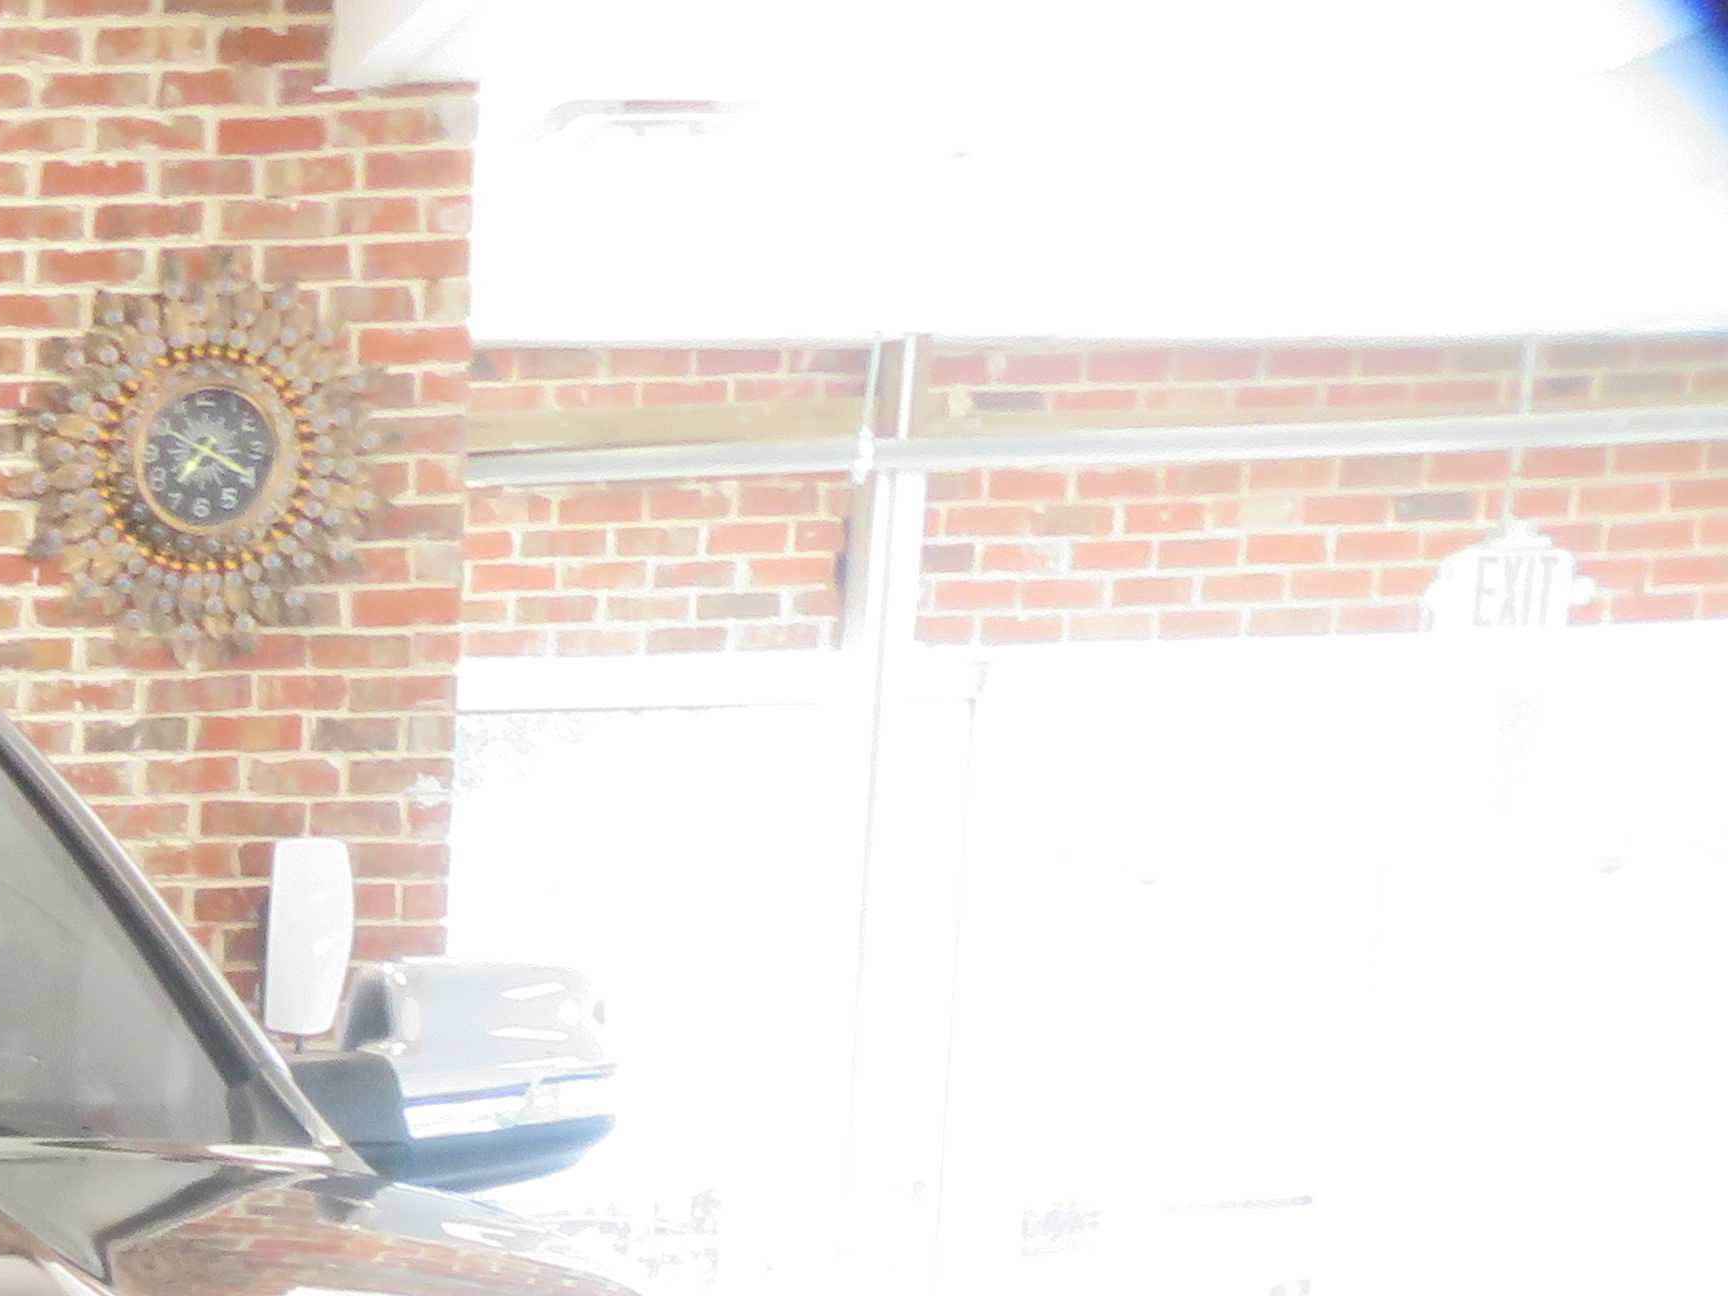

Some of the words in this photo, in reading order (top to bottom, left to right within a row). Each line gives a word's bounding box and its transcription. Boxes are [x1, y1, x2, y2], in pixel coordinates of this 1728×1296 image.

[167, 492, 184, 511] 7
[193, 497, 210, 518] 6
[221, 487, 239, 511] 5
[1472, 556, 1560, 626] EXIT
